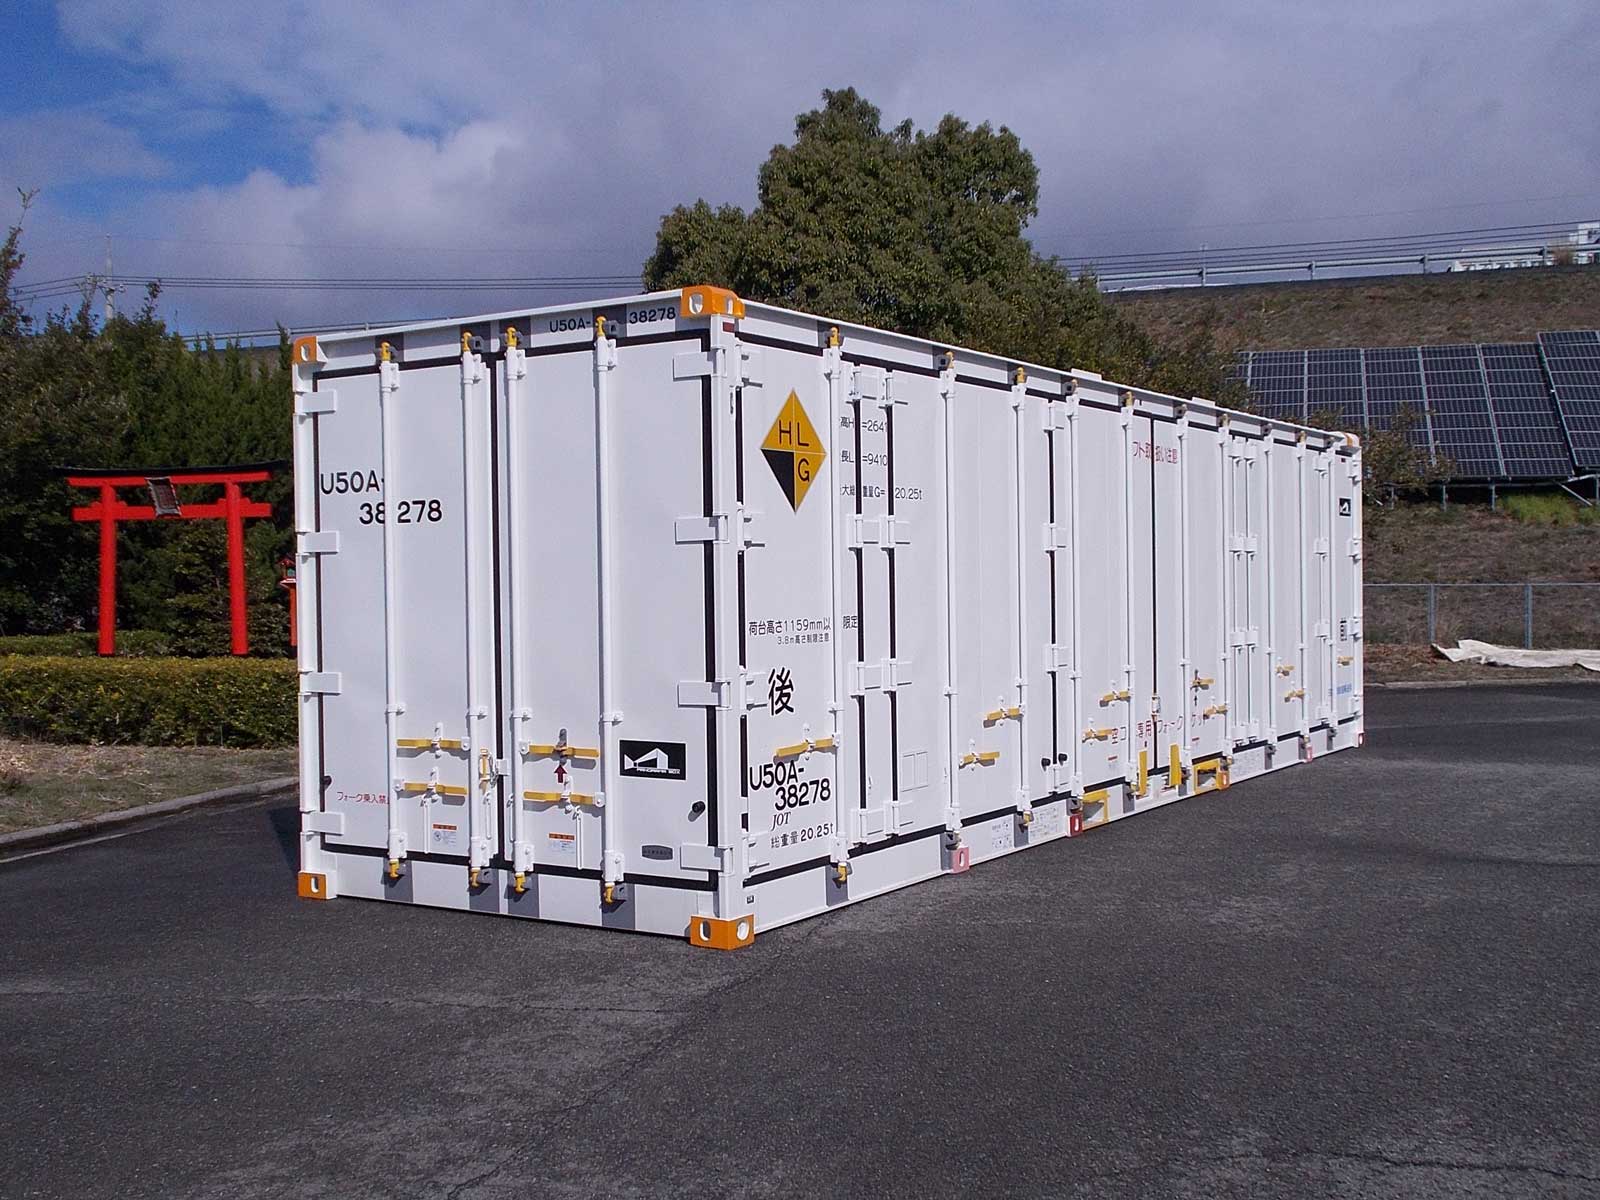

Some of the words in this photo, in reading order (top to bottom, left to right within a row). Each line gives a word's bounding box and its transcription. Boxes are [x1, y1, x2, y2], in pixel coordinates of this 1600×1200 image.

[549, 317, 591, 333] U50A-
[629, 307, 676, 324] 38278
[797, 458, 810, 482] G
[359, 499, 443, 525] 38278
[768, 666, 794, 716] 後
[749, 760, 805, 791] U50A-
[774, 778, 831, 811] 38278
[770, 811, 792, 832] JOT
